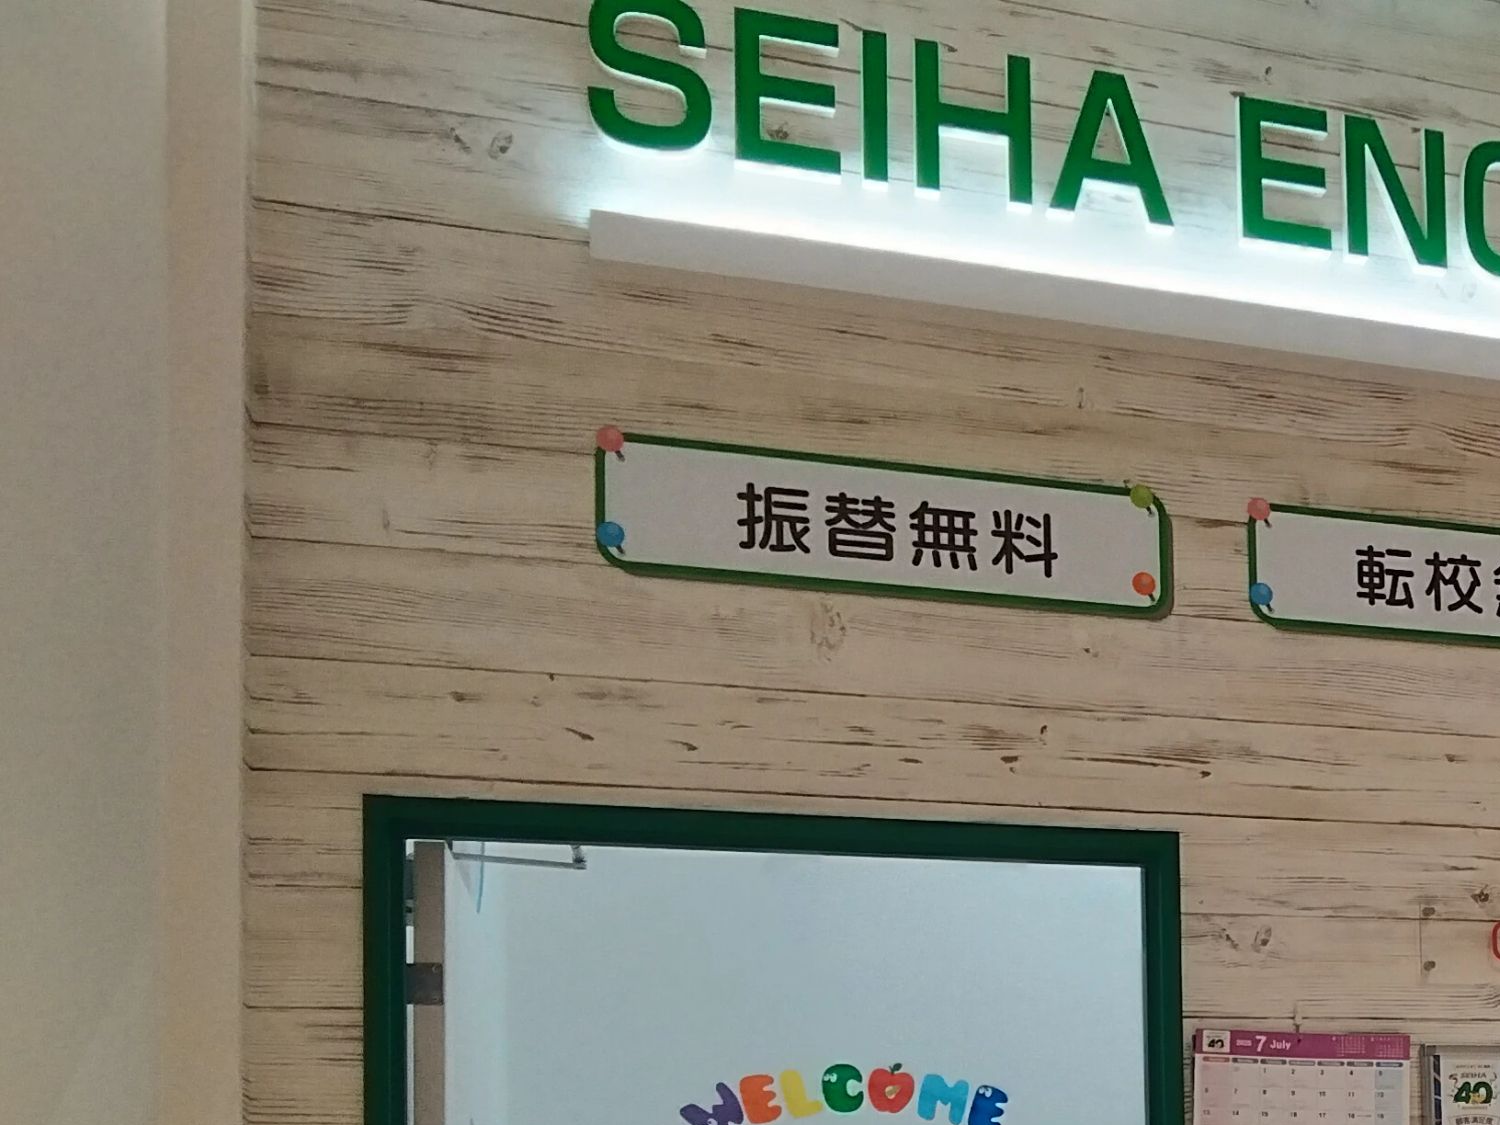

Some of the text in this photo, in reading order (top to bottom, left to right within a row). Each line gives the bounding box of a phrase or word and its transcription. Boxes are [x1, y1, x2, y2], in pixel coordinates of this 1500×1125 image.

[588, 0, 1174, 227] SEIHA
[736, 481, 1059, 579] 振替無料
[1255, 1035, 1291, 1051] 7 July
